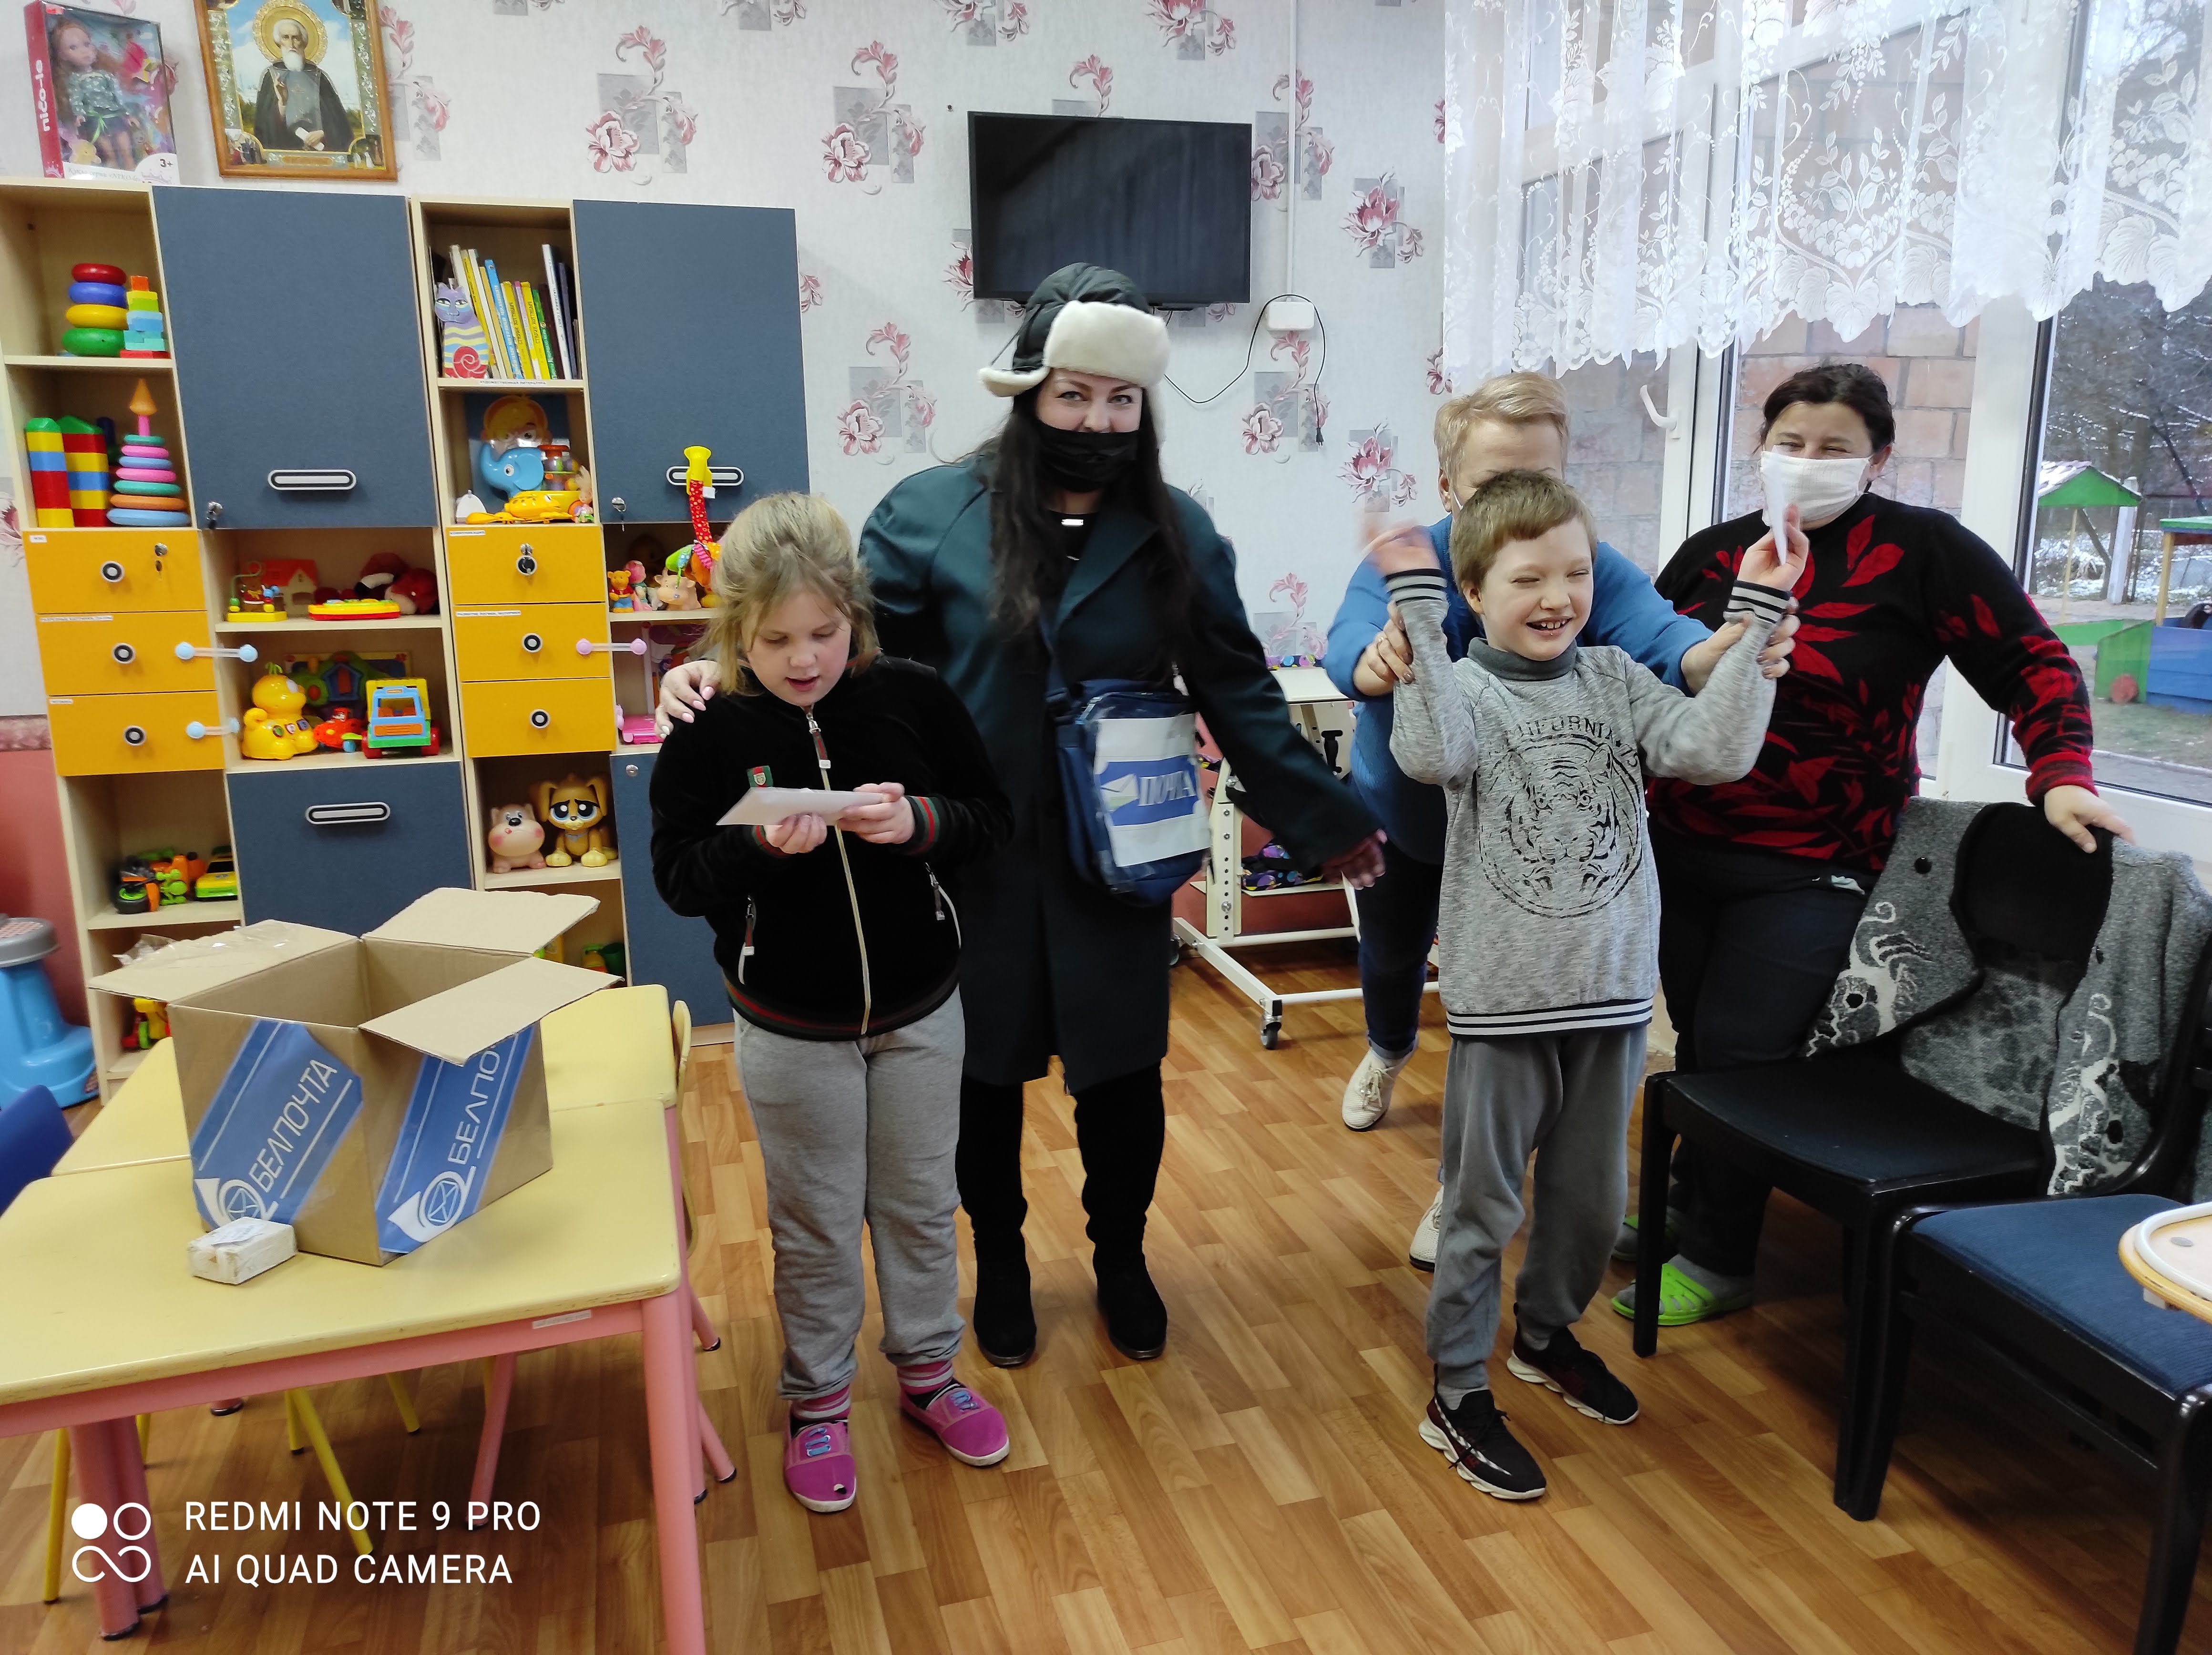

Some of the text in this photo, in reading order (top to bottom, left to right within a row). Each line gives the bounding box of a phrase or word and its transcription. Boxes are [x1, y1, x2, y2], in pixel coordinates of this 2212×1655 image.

[160, 158, 174, 168] 3+
[1501, 715, 1613, 744] LIFORNIA
[248, 1060, 337, 1193] БЕЛПОЧТА
[448, 1046, 500, 1165] БЕЛПО
